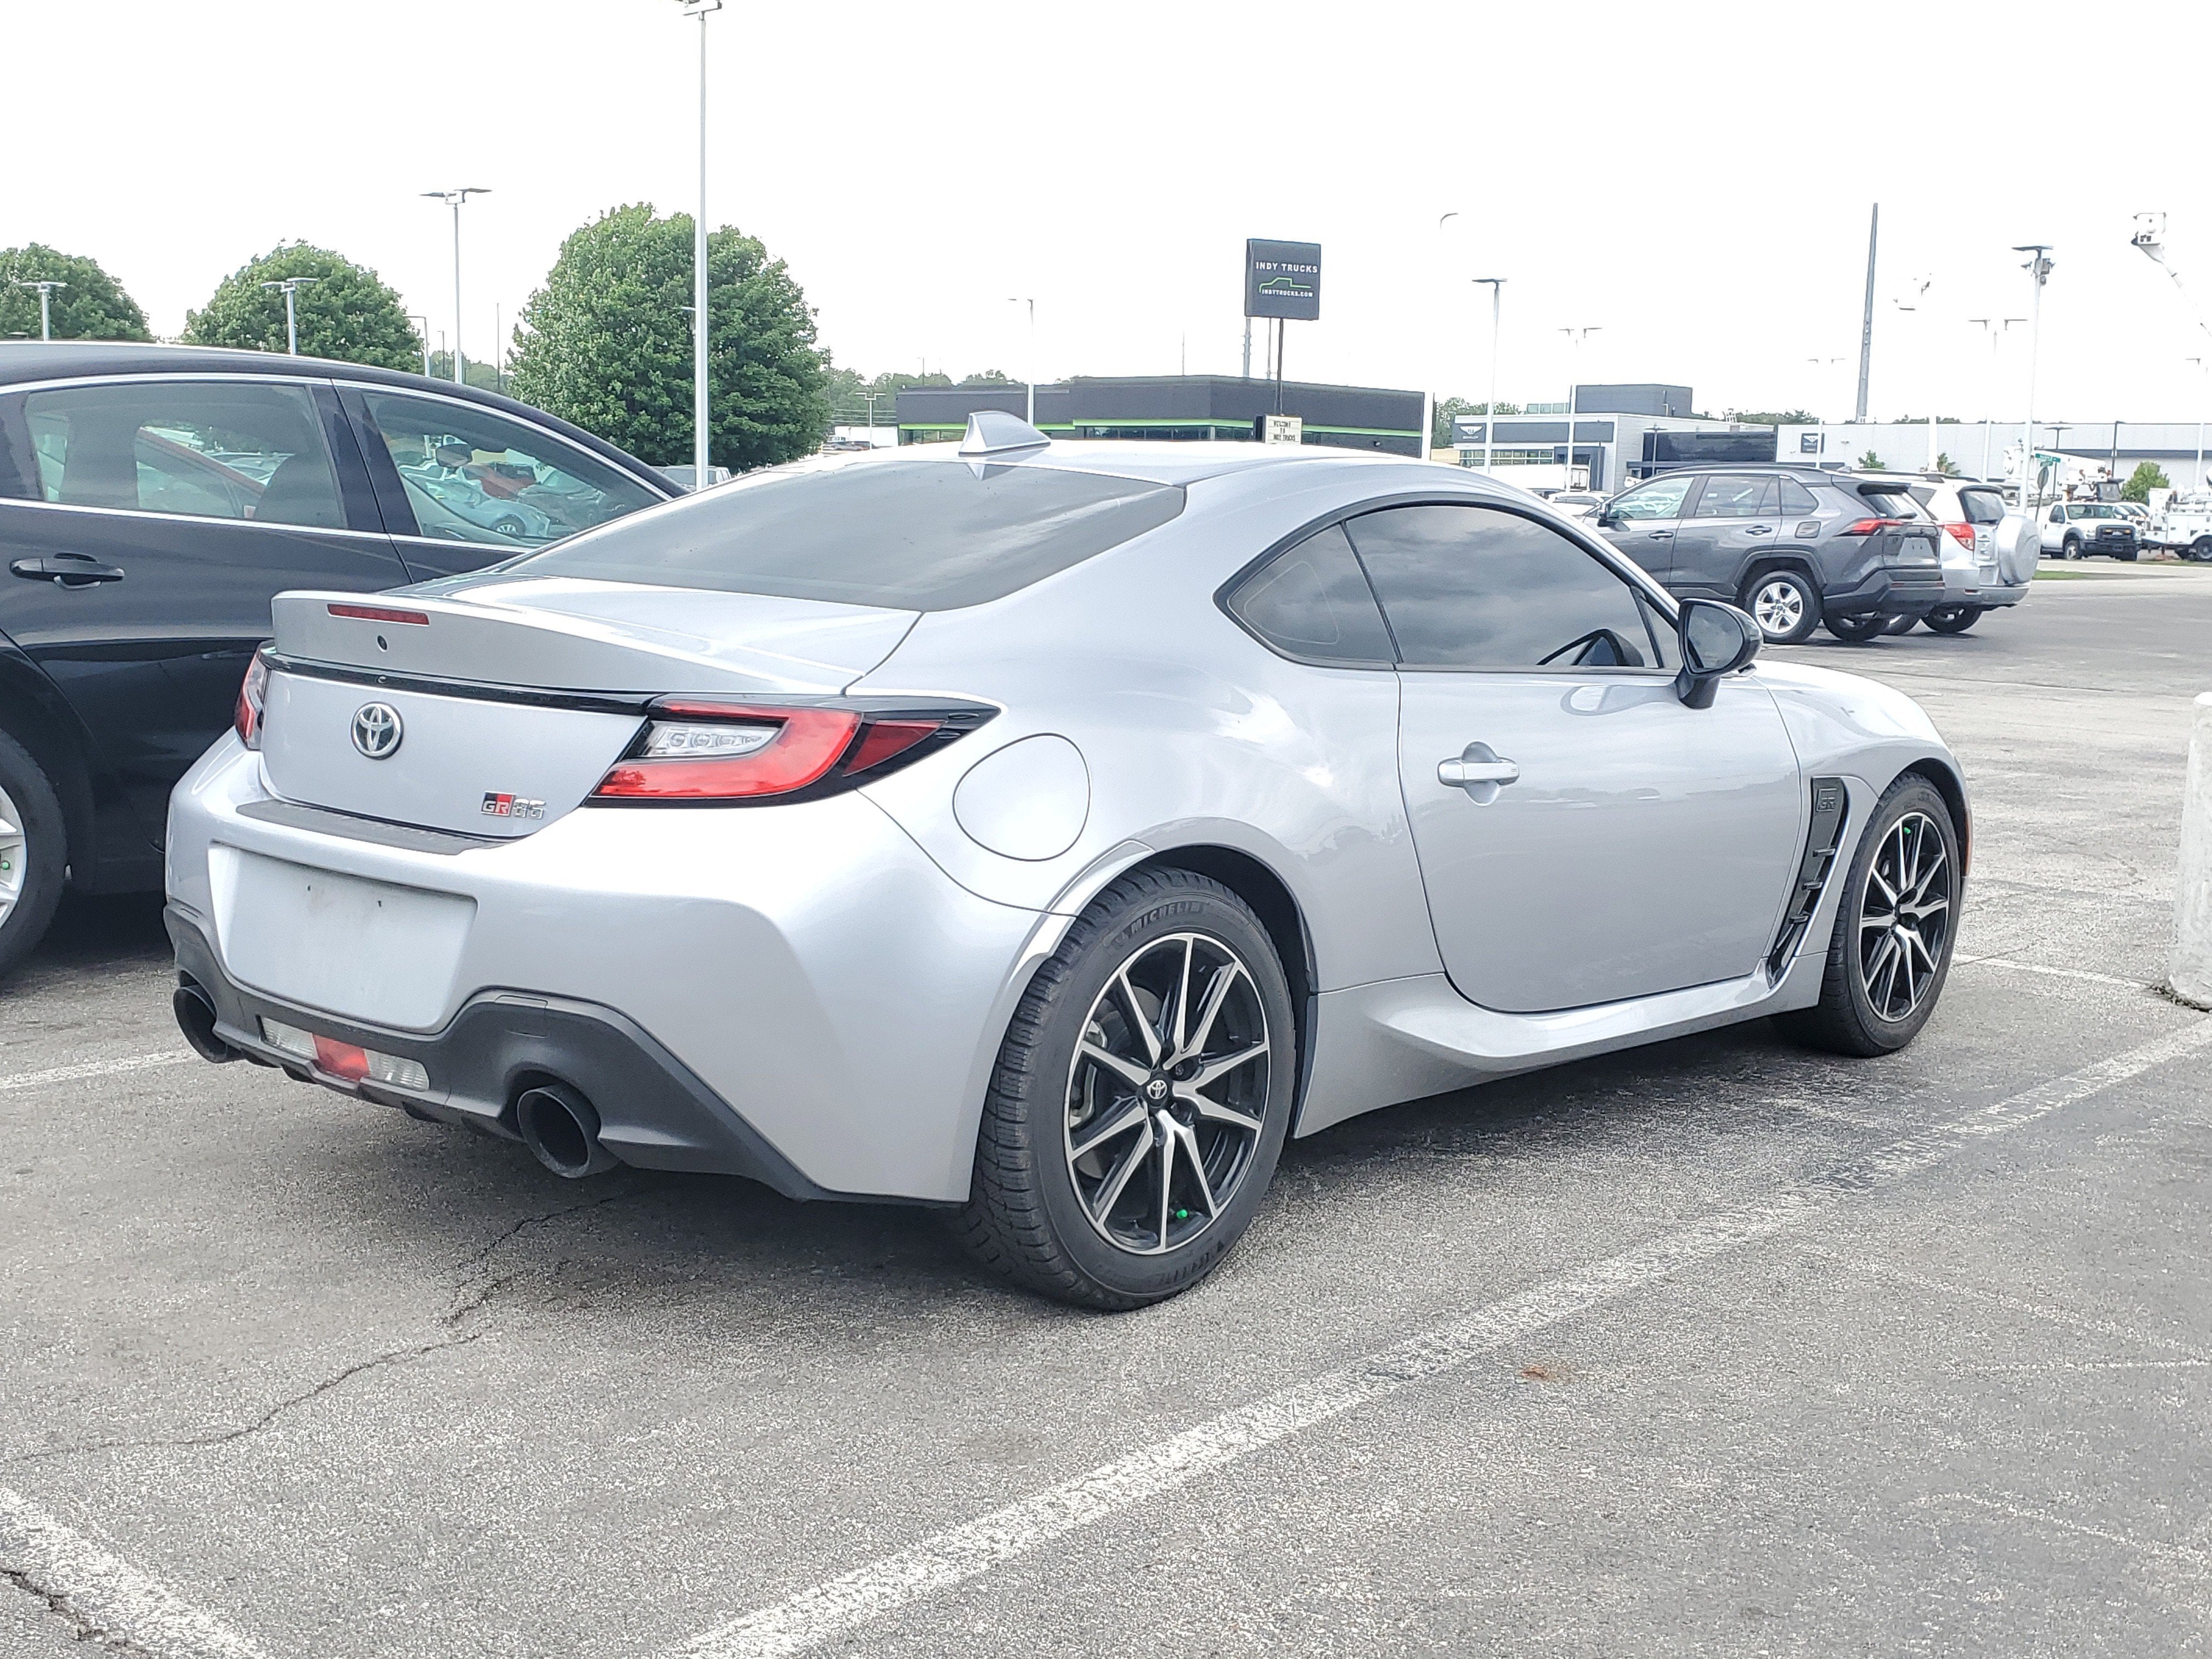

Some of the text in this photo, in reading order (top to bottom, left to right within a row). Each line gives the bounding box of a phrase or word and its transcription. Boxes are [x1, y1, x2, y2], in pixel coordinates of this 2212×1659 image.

[1256, 261, 1318, 273] INDY TRUCKS
[1262, 289, 1313, 297] INDYTRUCKS.COM
[483, 798, 547, 820] GR 86
